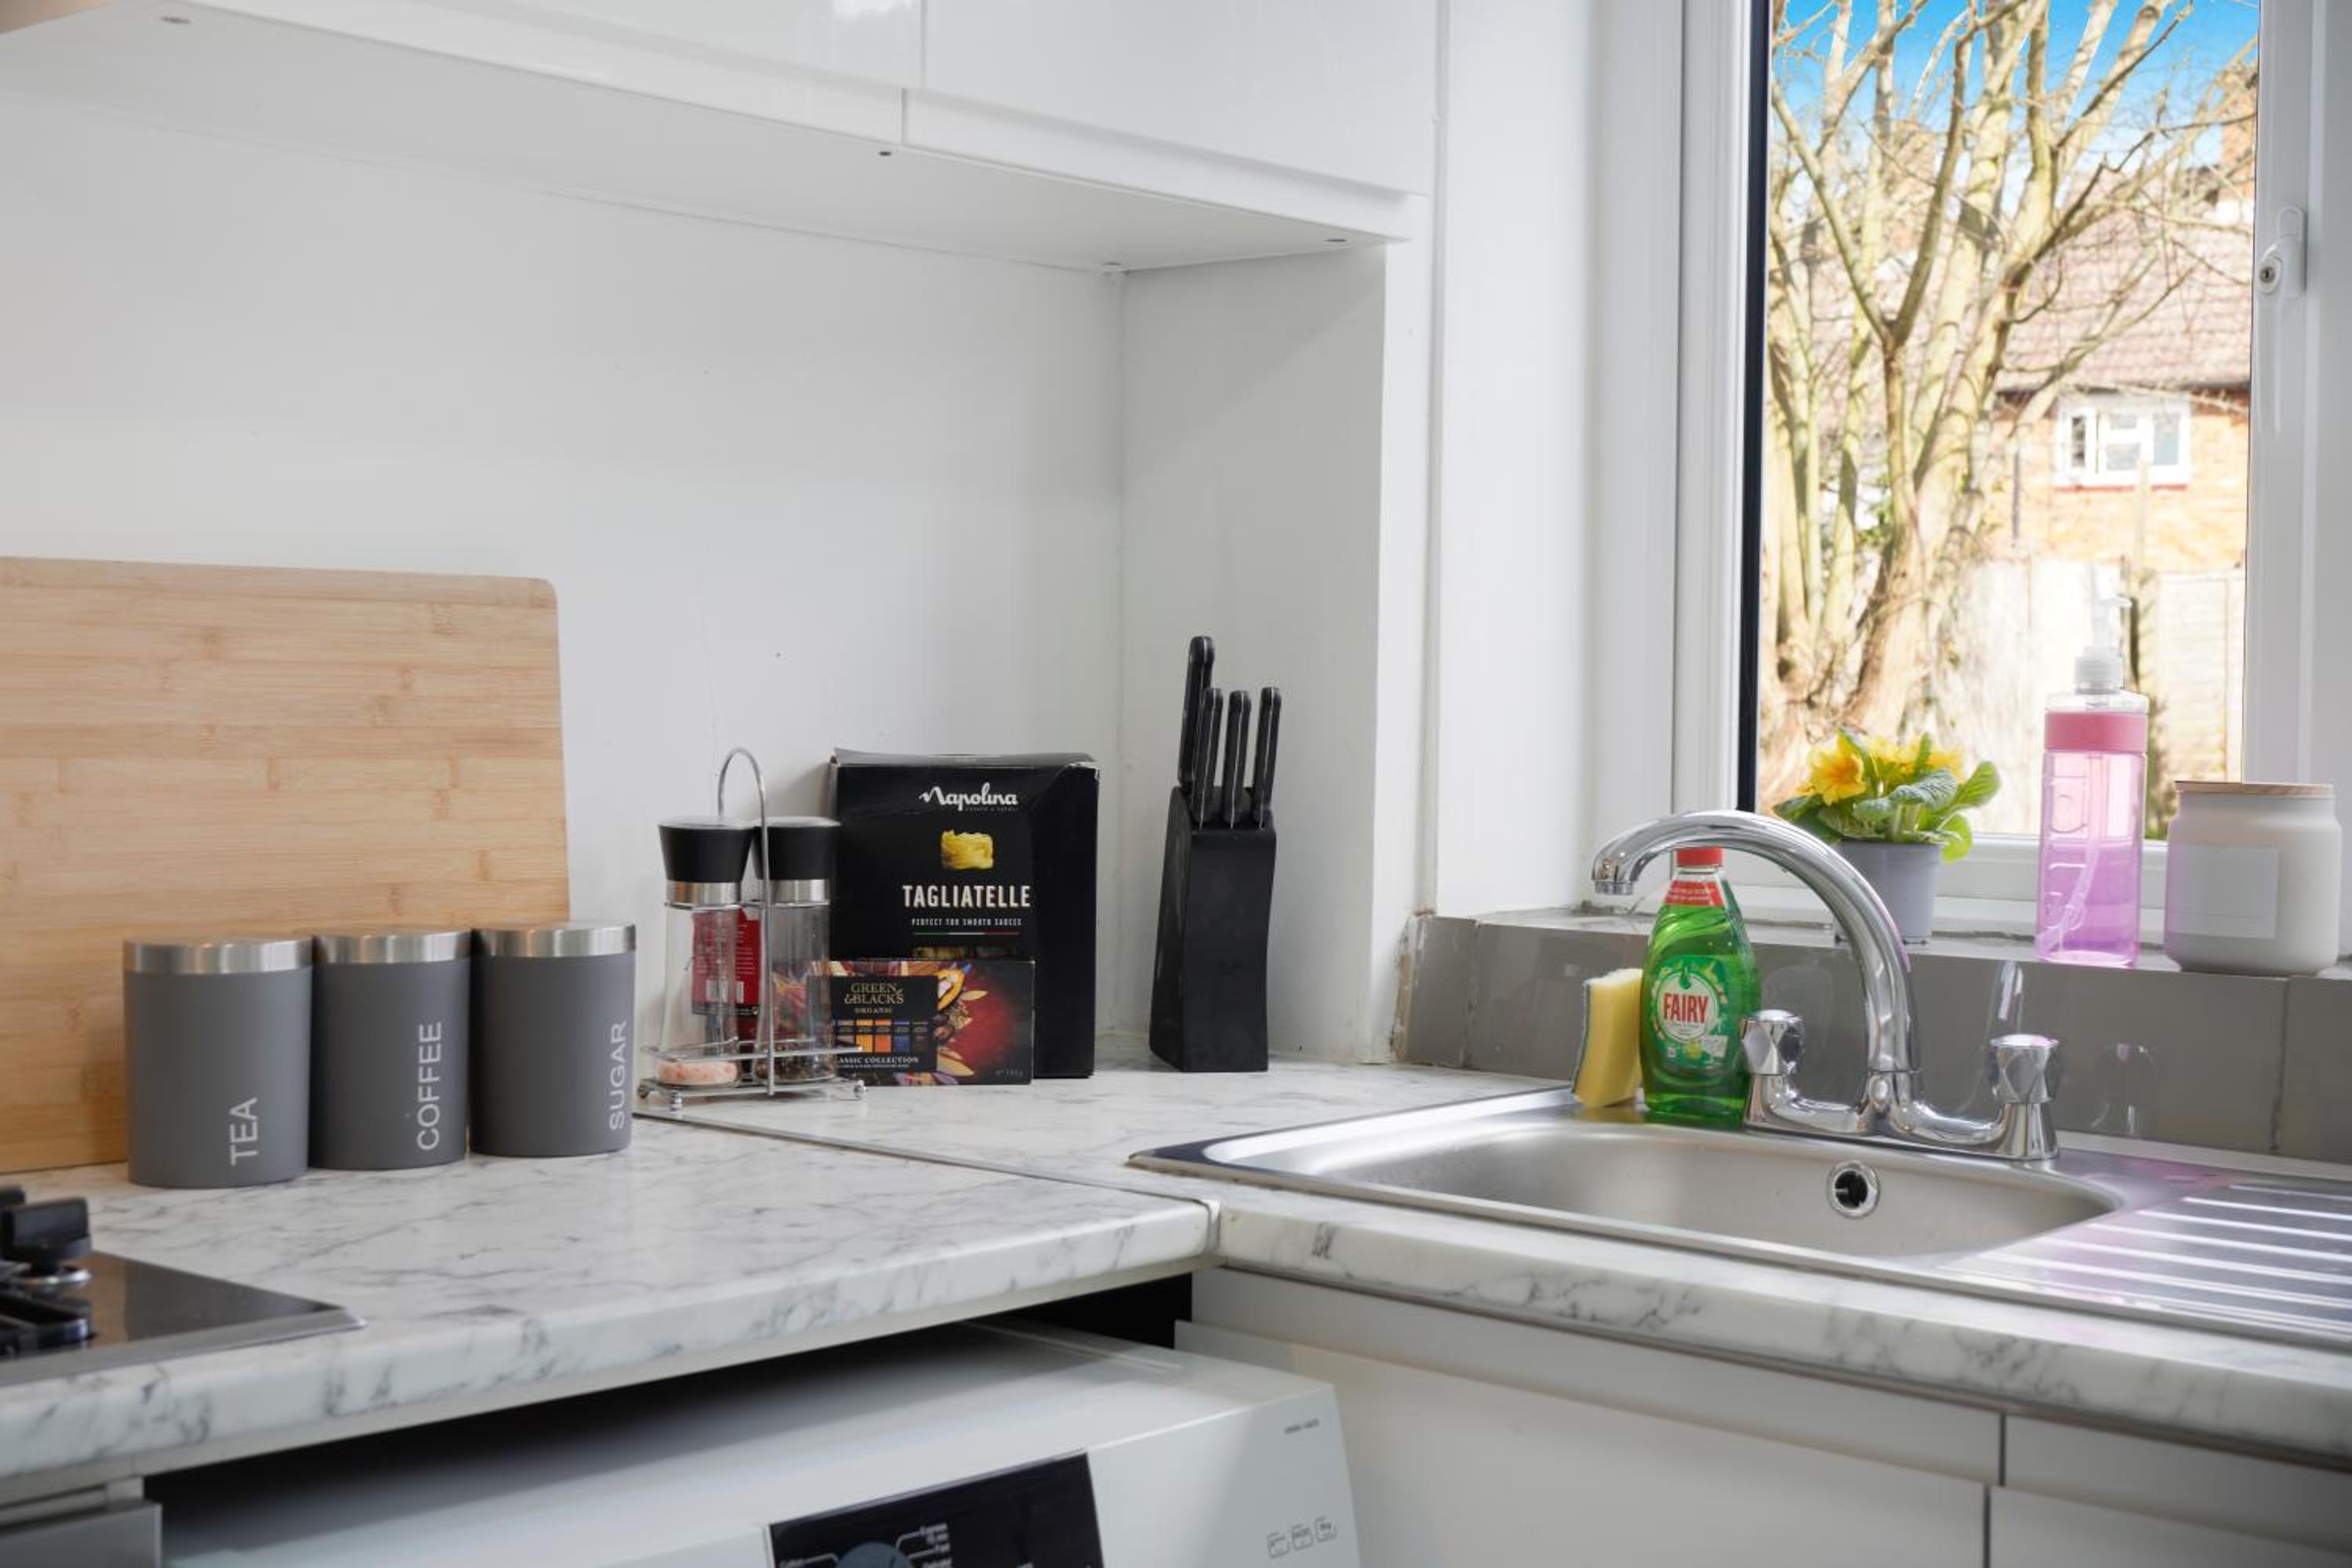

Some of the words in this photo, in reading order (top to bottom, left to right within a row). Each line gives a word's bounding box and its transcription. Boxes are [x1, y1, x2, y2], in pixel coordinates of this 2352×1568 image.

[919, 782, 1018, 811] Napolina
[902, 885, 1031, 908] TAGLIATELLE
[851, 982, 898, 993] GREEN
[1663, 993, 1709, 1024] FAIRY
[416, 1022, 441, 1151] COFFEE
[608, 1021, 627, 1131] SUGAR
[230, 1097, 259, 1167] TEA
